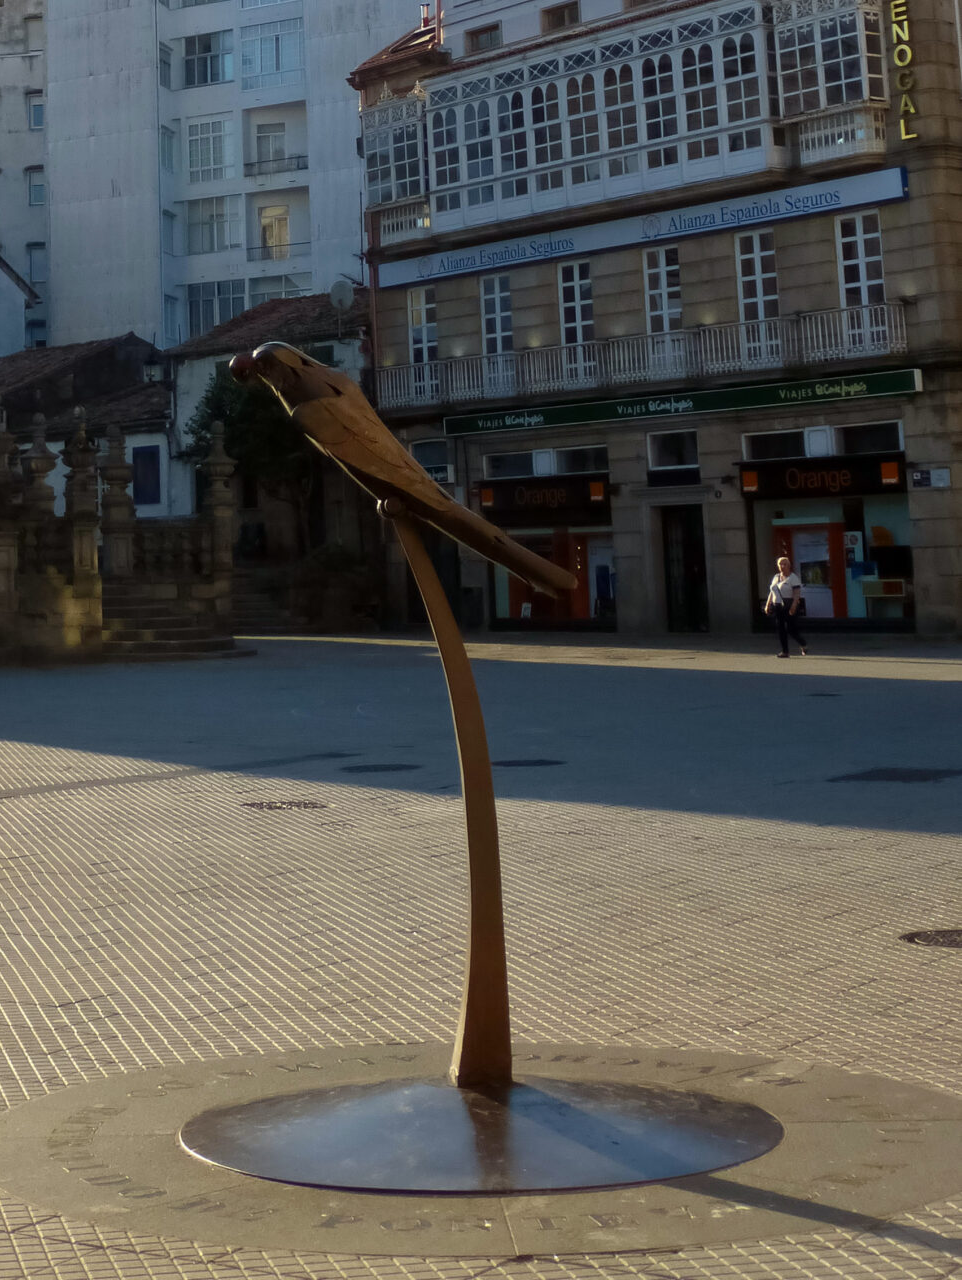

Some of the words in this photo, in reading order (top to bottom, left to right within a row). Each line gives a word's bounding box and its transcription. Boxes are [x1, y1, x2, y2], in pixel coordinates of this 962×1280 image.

[668, 211, 716, 232] Alianza
[720, 197, 781, 224] Española
[784, 189, 841, 213] Seguros
[438, 257, 476, 273] Alianza
[479, 243, 527, 266] Española
[529, 237, 575, 257] Seguros
[514, 485, 567, 508] Orange
[787, 467, 852, 493] Orange
[512, 1053, 806, 1087] RAVACHO
